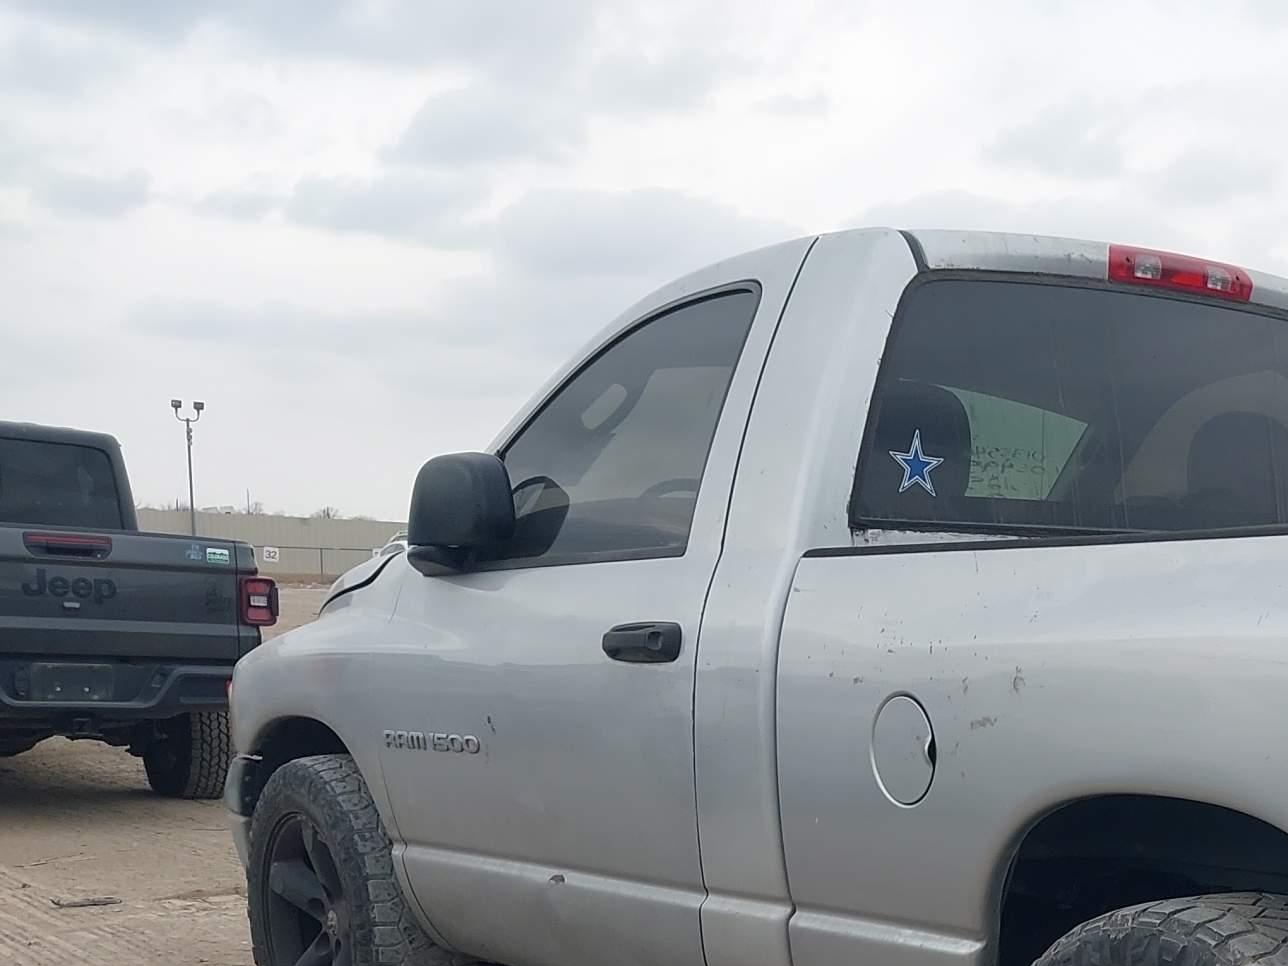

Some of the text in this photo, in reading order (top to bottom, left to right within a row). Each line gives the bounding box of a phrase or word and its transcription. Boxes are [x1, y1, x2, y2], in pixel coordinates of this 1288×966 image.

[265, 550, 277, 560] 32
[22, 568, 117, 604] Jeep
[383, 729, 481, 754] RAM 1500
